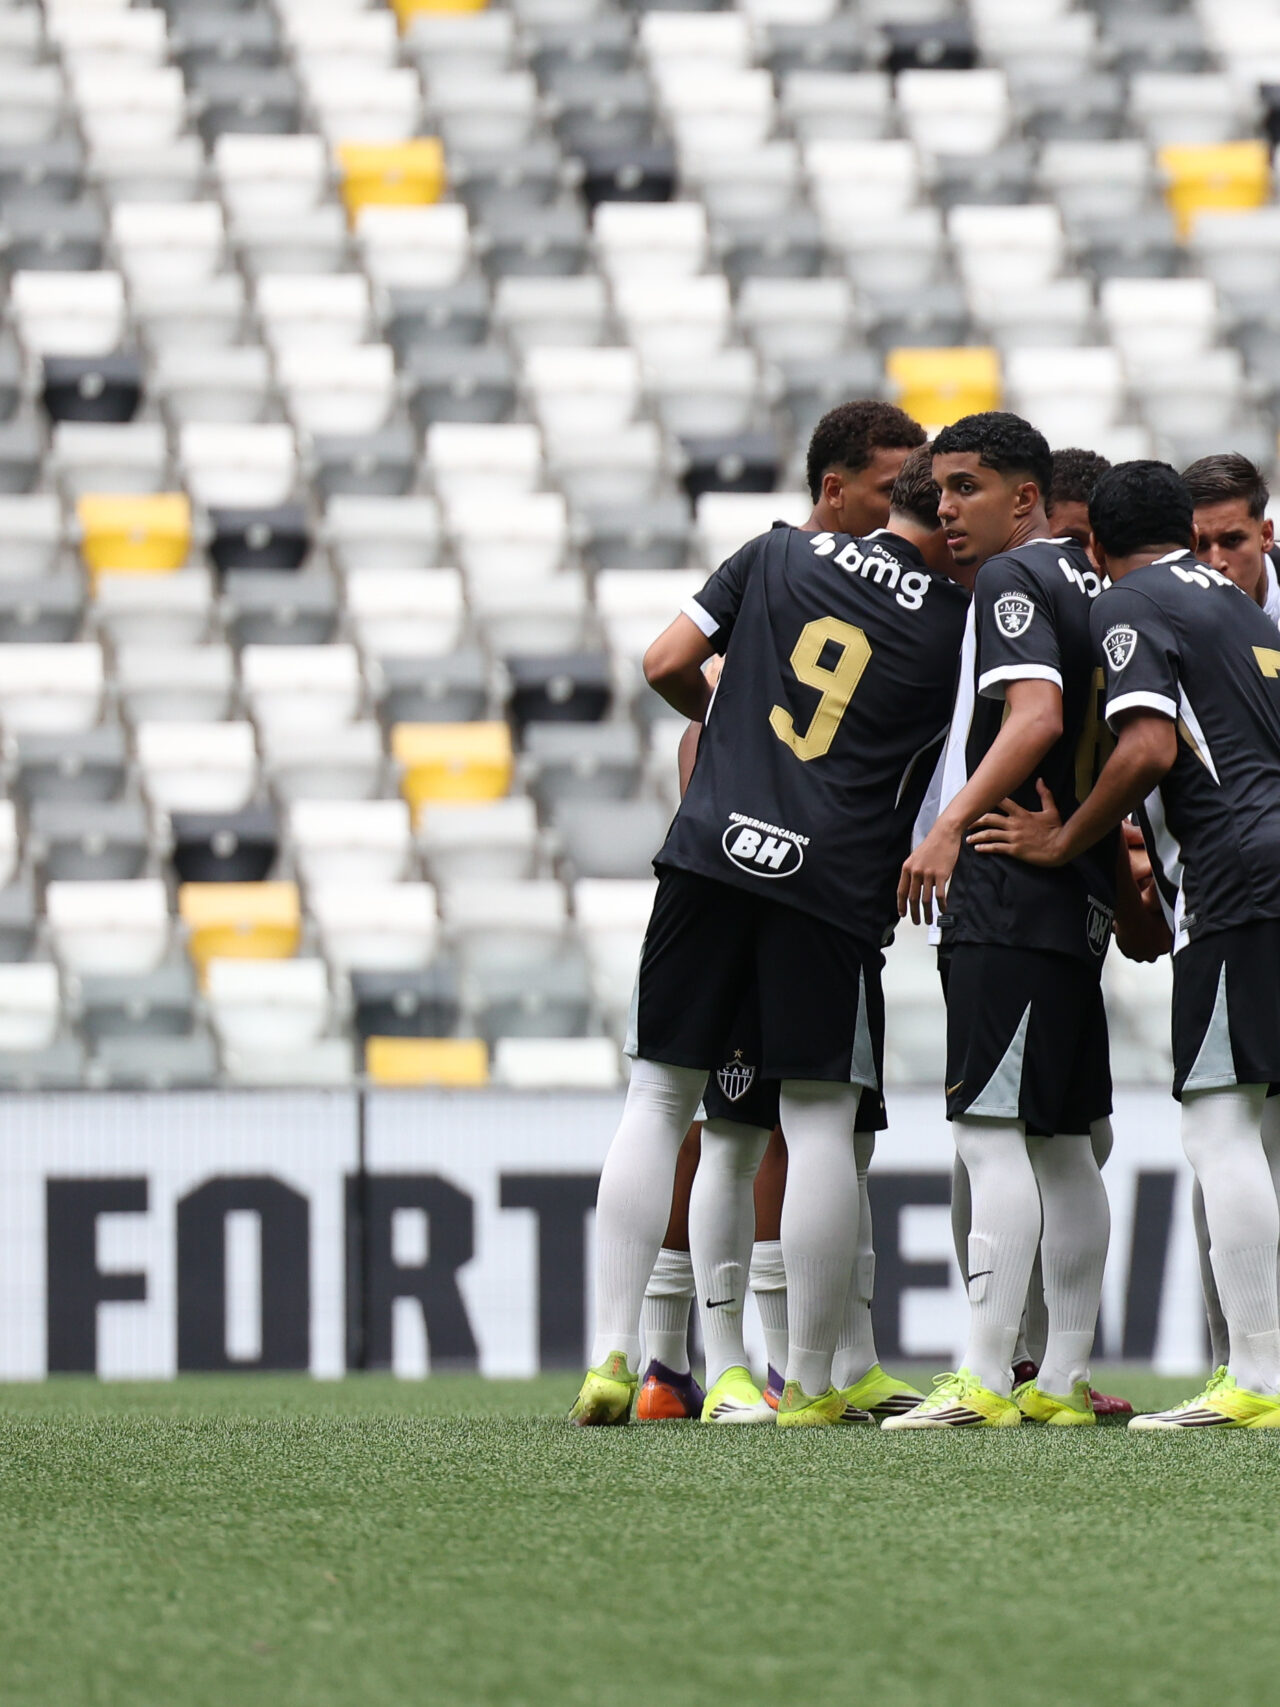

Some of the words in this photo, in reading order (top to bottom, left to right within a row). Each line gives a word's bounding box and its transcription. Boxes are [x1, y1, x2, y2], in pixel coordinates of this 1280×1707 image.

[833, 541, 932, 610] bmg
[1004, 602, 1023, 612] M2
[1110, 634, 1127, 647] M2
[769, 616, 873, 762] 9
[728, 812, 810, 846] SUPERMERCADOS
[730, 827, 792, 870] BH
[46, 1173, 706, 1372] FORT
